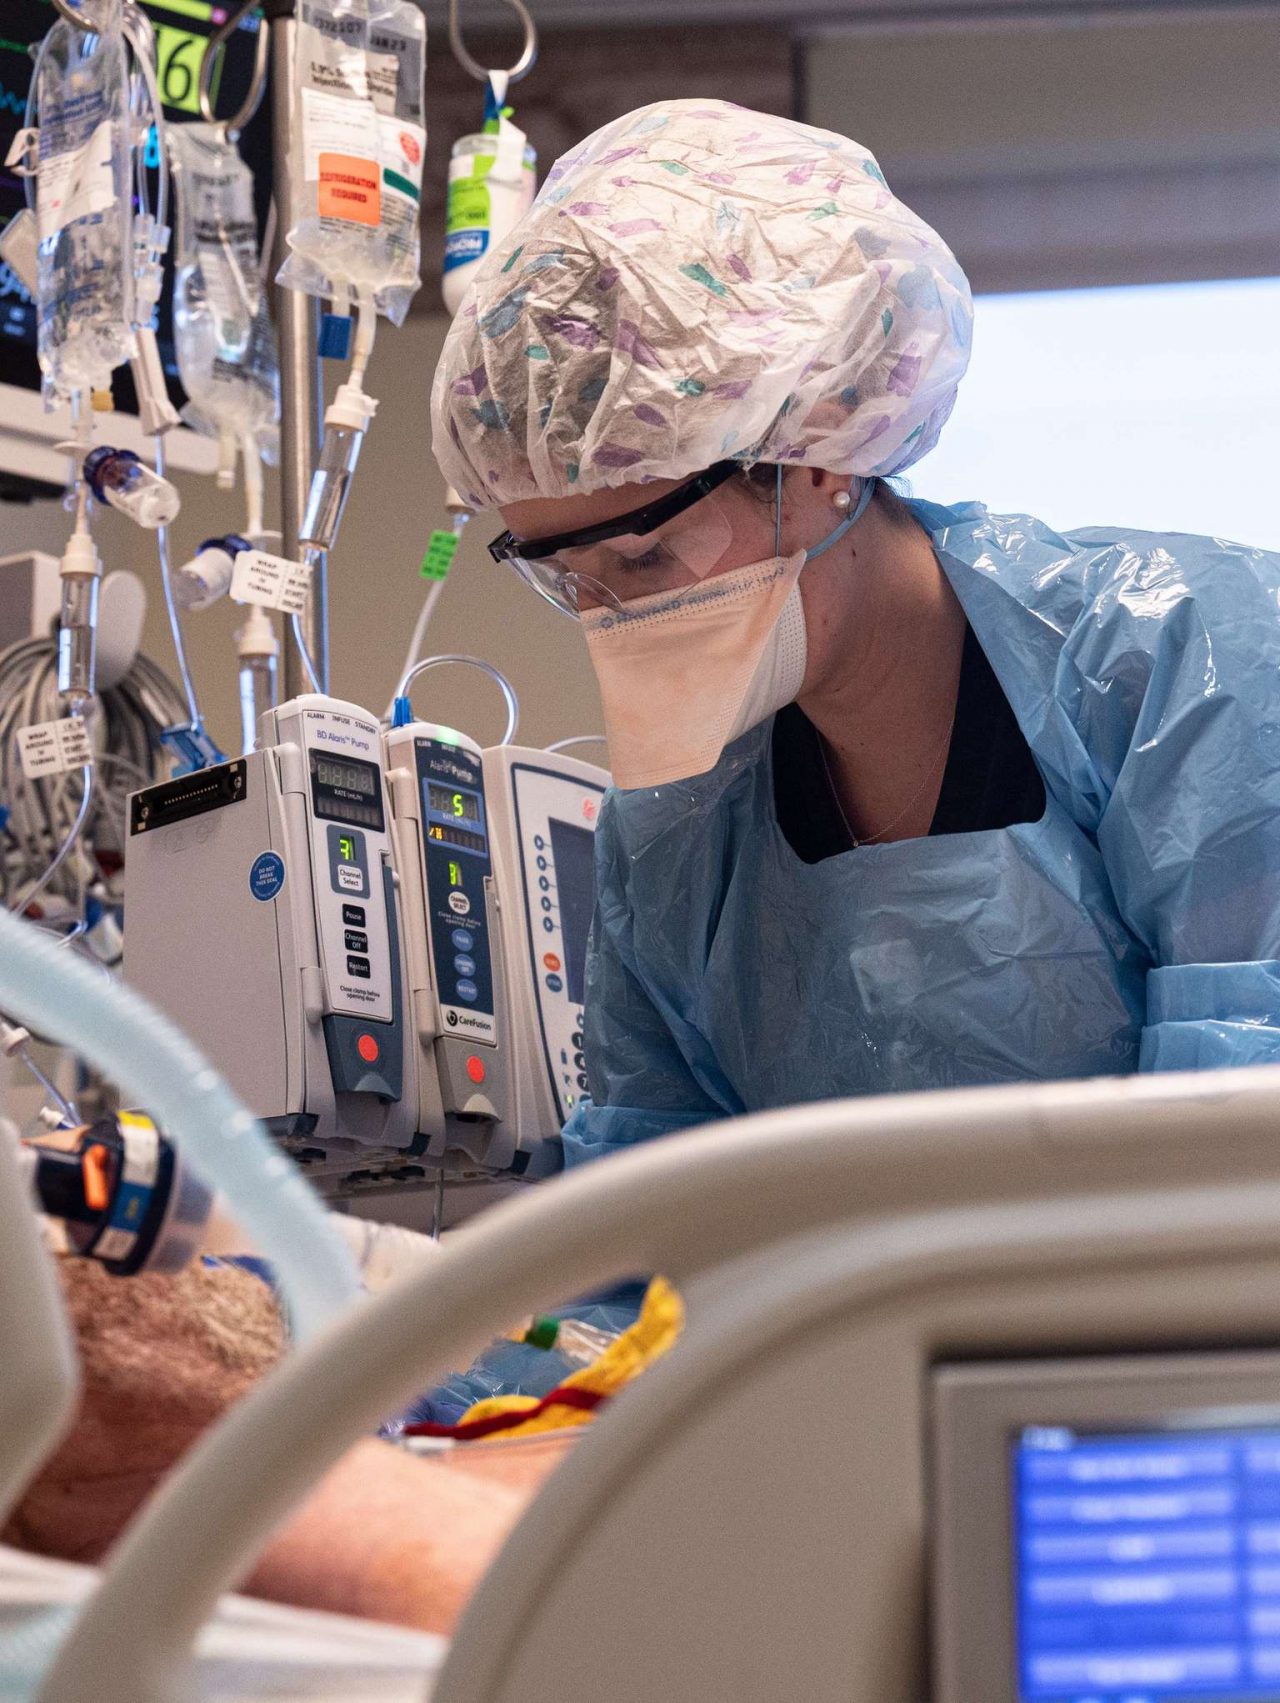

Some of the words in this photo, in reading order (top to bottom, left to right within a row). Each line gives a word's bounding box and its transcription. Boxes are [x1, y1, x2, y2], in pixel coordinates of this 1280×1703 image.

[307, 712, 325, 720] ALARM
[332, 715, 351, 726] INFUSE
[355, 721, 376, 735] STANDBY
[316, 729, 328, 740] BD
[351, 737, 370, 751] Pump
[339, 869, 361, 880] Channel
[343, 877, 359, 887] Select
[346, 911, 362, 920] Pause
[345, 933, 367, 943] Channel
[351, 941, 361, 949] Off
[348, 962, 368, 971] Restart
[340, 985, 352, 993] Close
[367, 989, 380, 998] before
[459, 1015, 492, 1031] CareFusion
